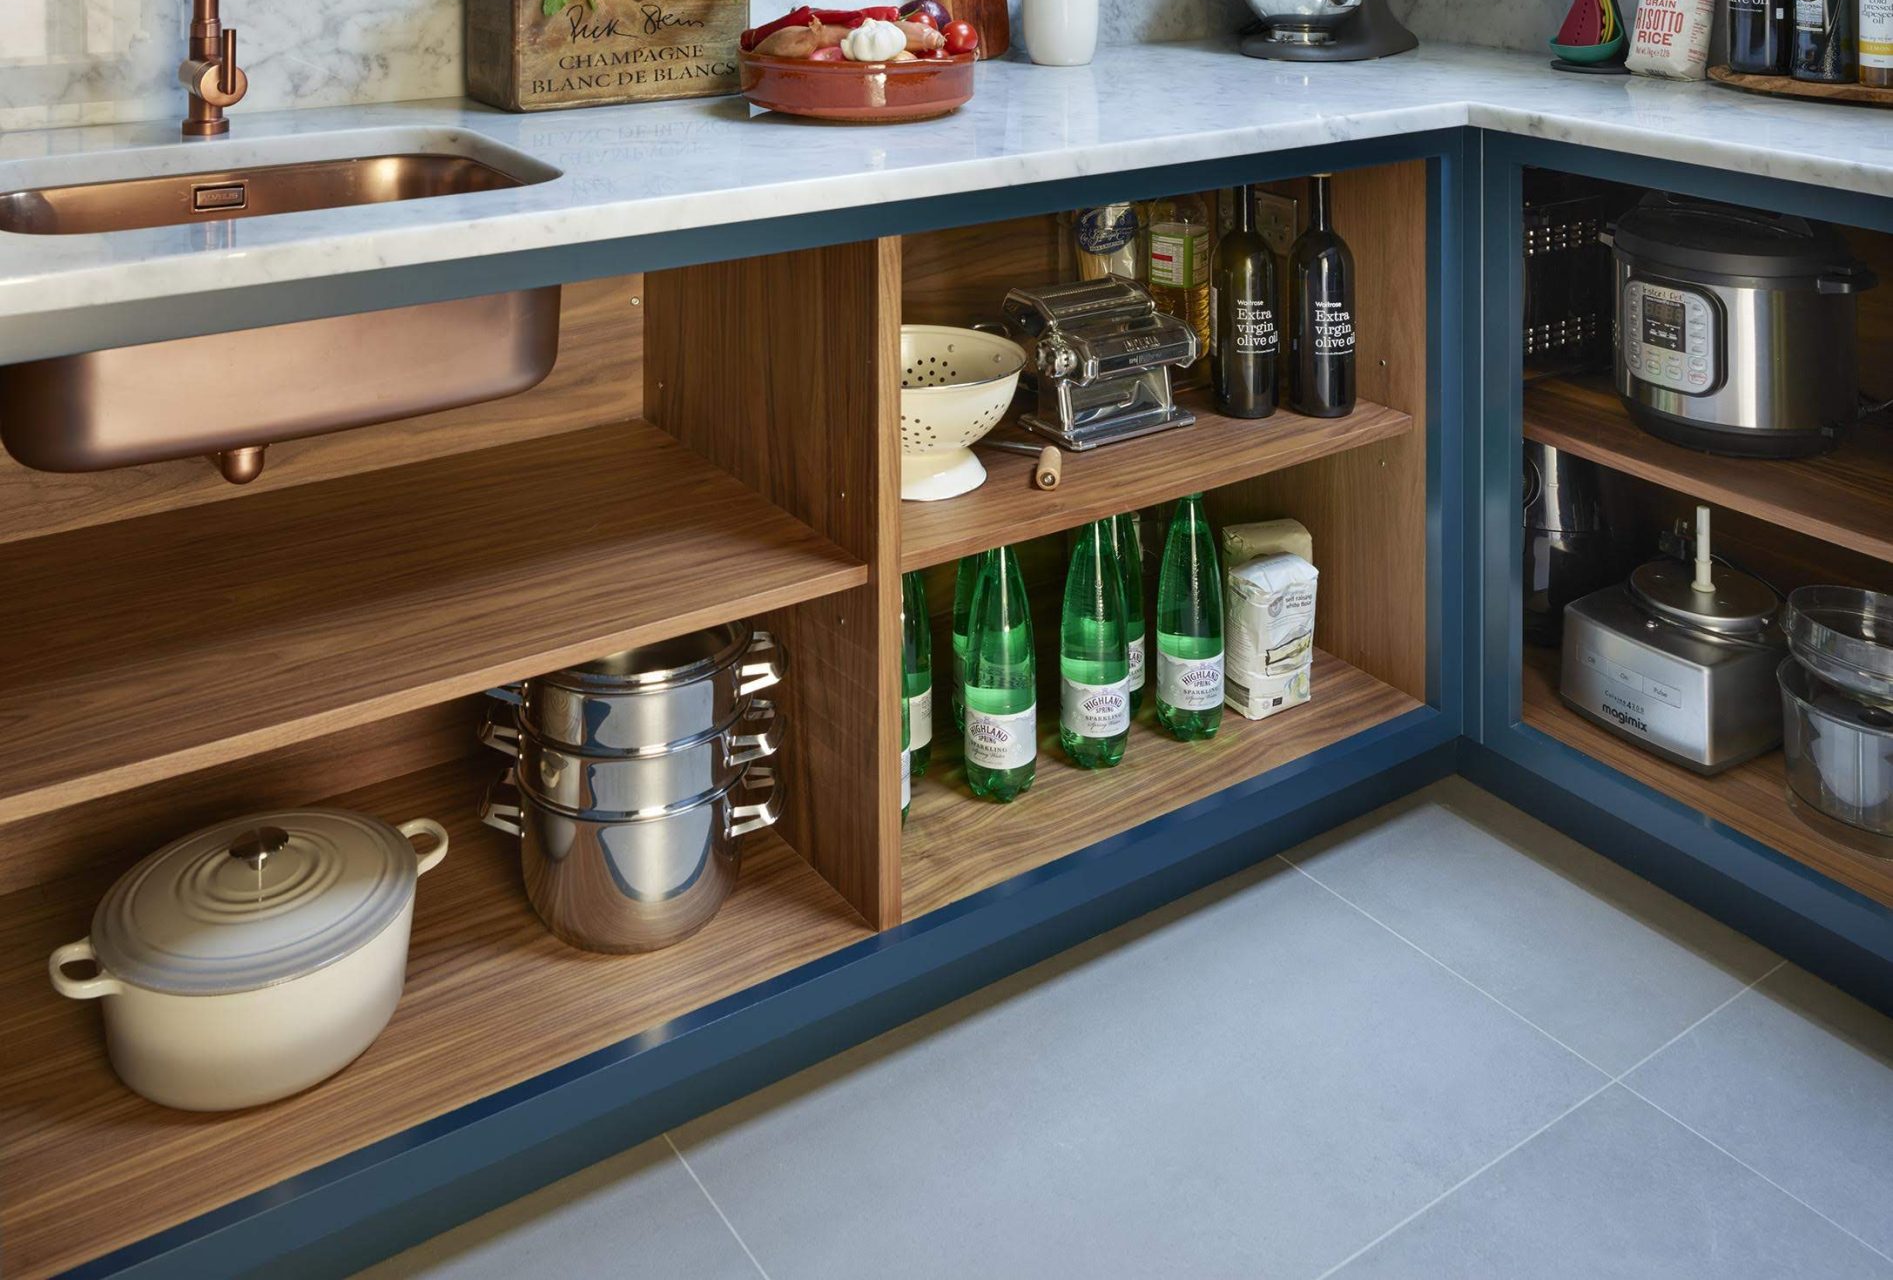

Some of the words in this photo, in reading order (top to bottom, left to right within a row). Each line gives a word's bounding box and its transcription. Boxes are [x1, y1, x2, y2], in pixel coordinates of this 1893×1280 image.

[1636, 7, 1684, 34] RISOTTO
[1637, 30, 1673, 46] RICE
[559, 44, 704, 70] CHAMPAGNE
[532, 73, 611, 94] BLANC
[617, 71, 648, 86] DE
[653, 61, 737, 82] BLANCS
[1643, 285, 1666, 299] Instant
[1237, 308, 1272, 320] Extra
[1315, 310, 1350, 322] Extra
[1237, 321, 1274, 335] virgin
[1315, 322, 1352, 337] virgin
[1237, 334, 1267, 347] olive
[1268, 330, 1279, 345] oil
[1315, 336, 1346, 348] olive
[1346, 331, 1356, 346] oil
[1182, 670, 1219, 685] HIGHLAND
[1620, 672, 1629, 681] On
[1183, 687, 1218, 695] SPARKLING
[1653, 687, 1668, 698] Pulse
[1083, 696, 1122, 711] HIGHLAND
[1096, 706, 1115, 714] SPRING
[1085, 713, 1121, 722] SPARKLING
[1602, 703, 1648, 732] magimix
[969, 724, 1009, 742] HIGHLAND
[978, 735, 997, 745] SPRING
[969, 740, 1008, 754] SPARKLING
